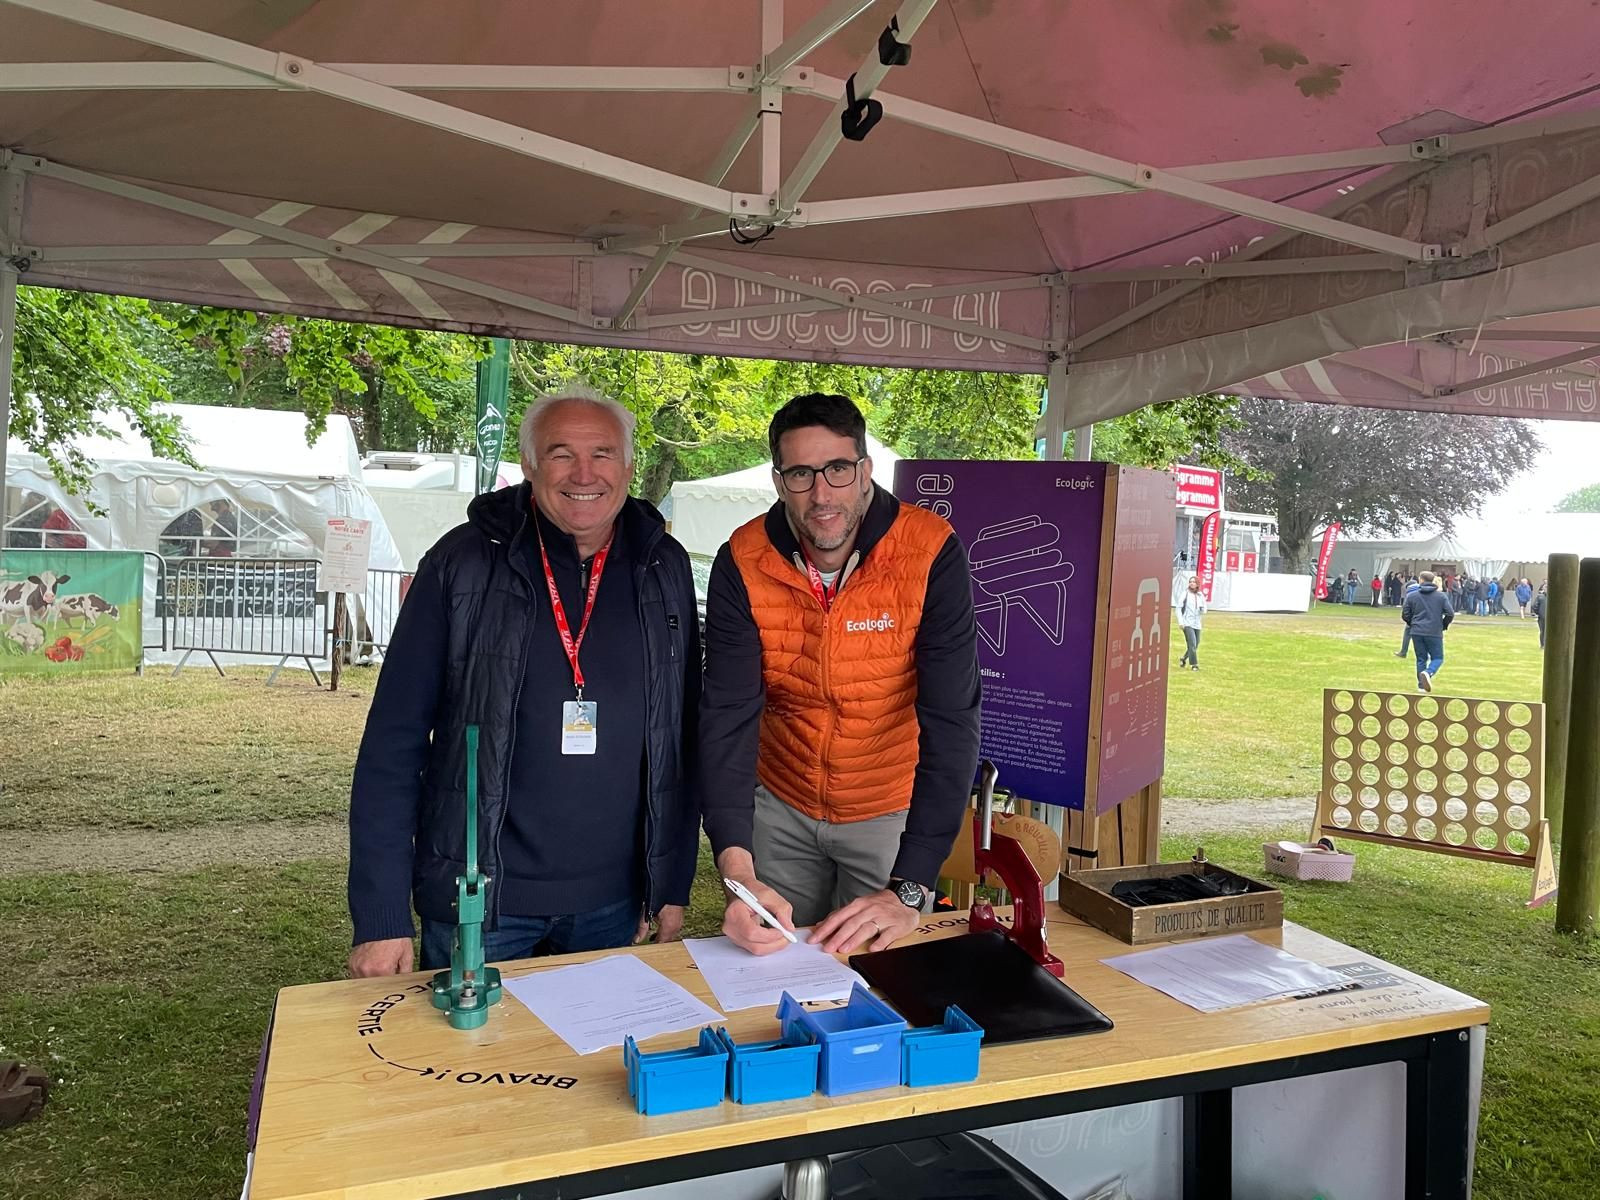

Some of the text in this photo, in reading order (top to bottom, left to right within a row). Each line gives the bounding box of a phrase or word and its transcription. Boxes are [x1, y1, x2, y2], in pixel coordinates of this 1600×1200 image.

[1055, 475, 1095, 491] EcoLogic
[846, 613, 896, 632] EcoLogic
[980, 668, 1001, 678] tilise
[913, 917, 969, 935] ROUE
[1154, 903, 1265, 934] PRODUITS DE QUALITE
[455, 1072, 579, 1090] BRAVO
